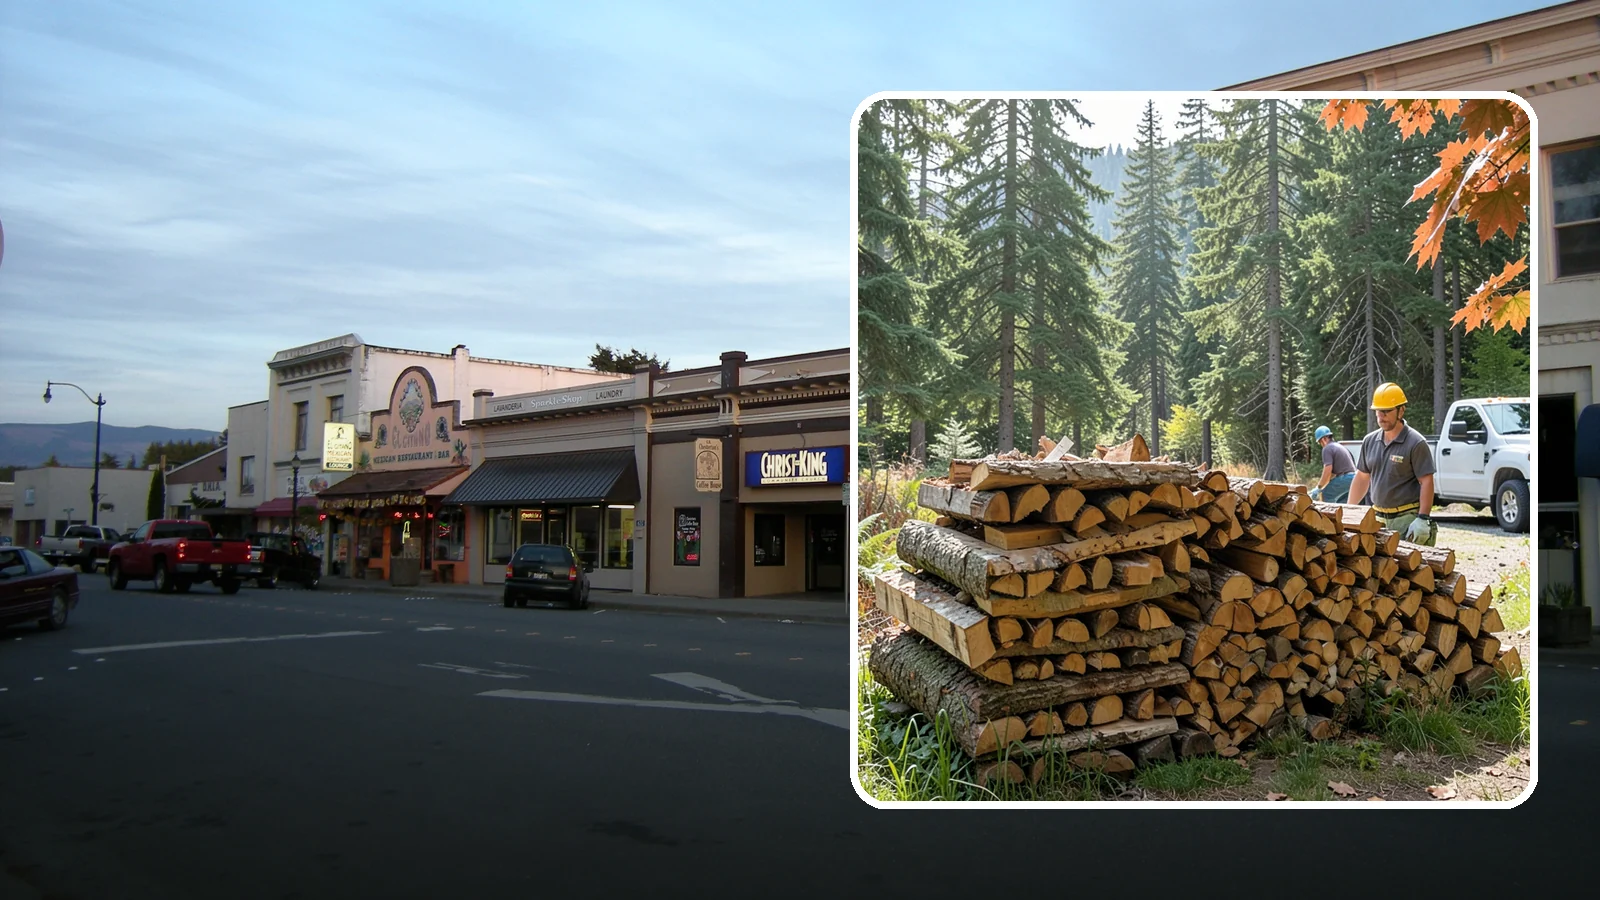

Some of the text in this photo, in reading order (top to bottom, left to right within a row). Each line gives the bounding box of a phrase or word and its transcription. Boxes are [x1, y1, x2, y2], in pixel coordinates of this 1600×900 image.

[595, 389, 624, 400] LAUNDRY
[493, 402, 522, 412] LAVANDERIA
[373, 450, 450, 464] MEXICAN RESTAURANT BAR
